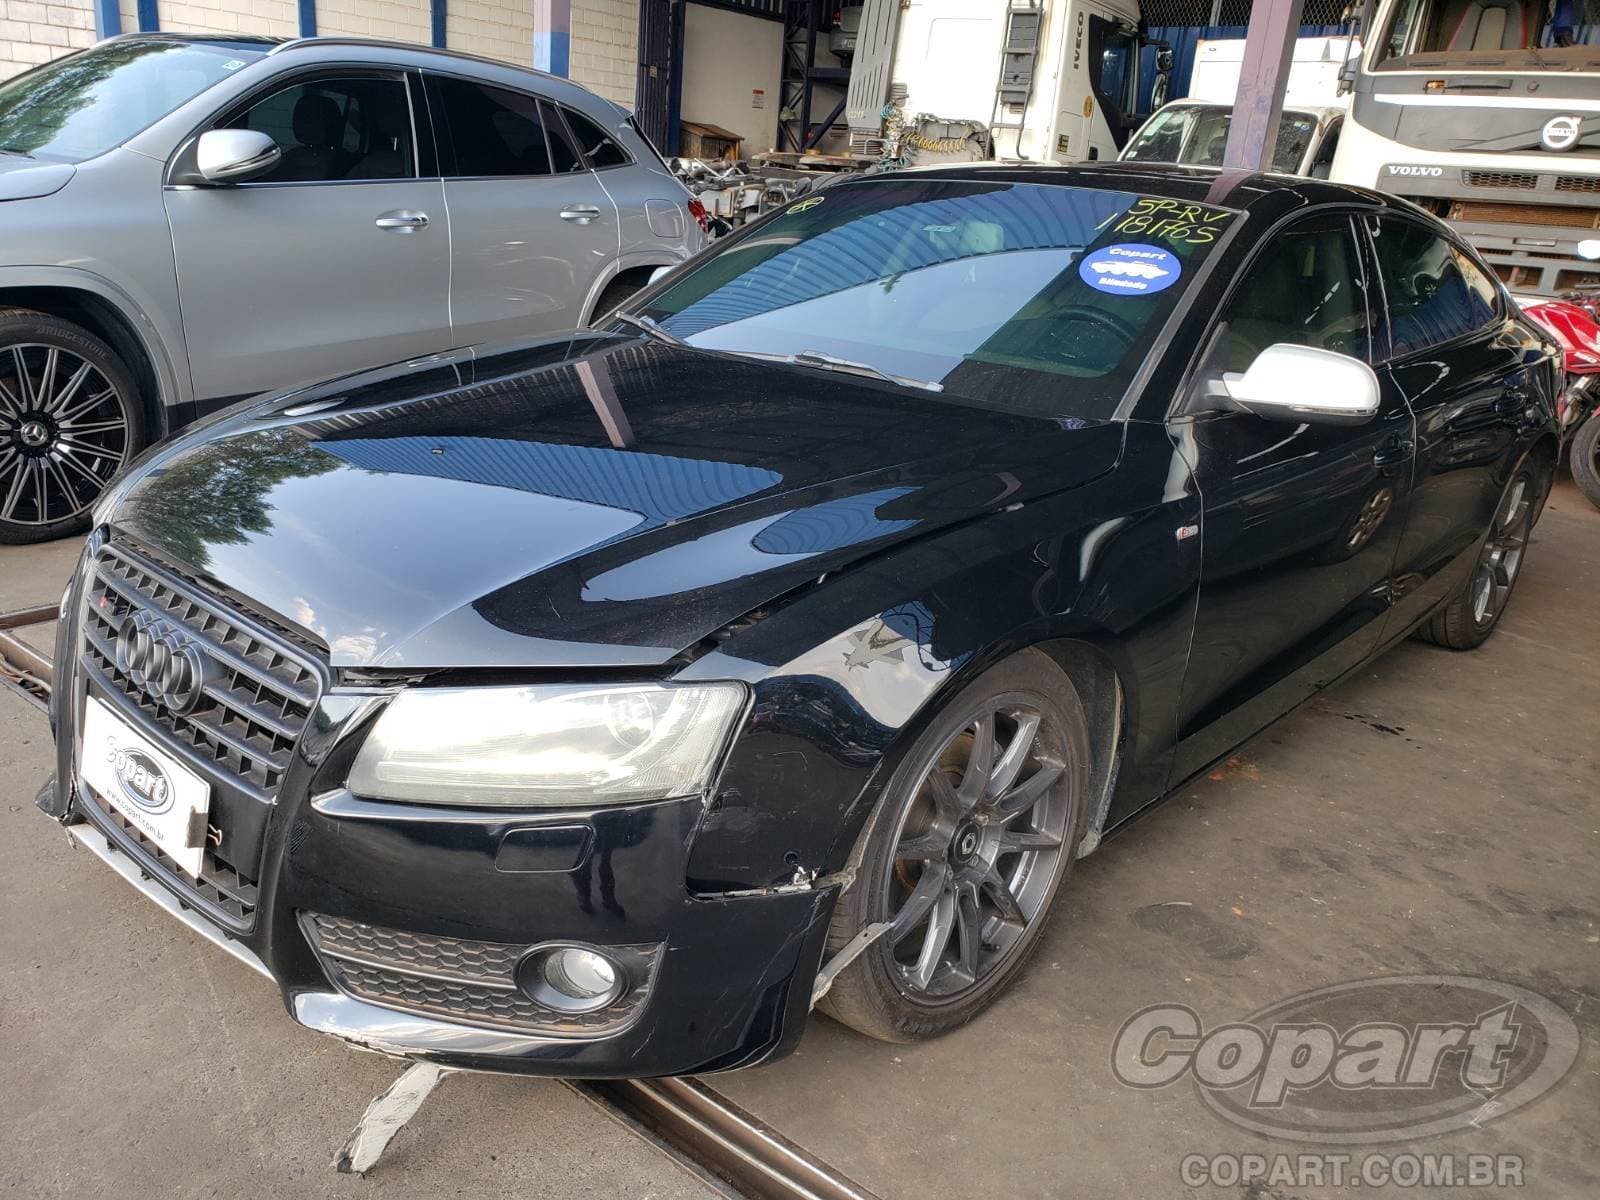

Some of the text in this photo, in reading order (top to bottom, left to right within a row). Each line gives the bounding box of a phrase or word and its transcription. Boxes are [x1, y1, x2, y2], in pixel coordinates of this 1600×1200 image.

[1073, 11, 1084, 70] IVECO
[1388, 165, 1443, 177] VOLVO
[1109, 249, 1168, 261] Copart
[105, 735, 168, 801] Copart
[106, 790, 165, 842] www.copart.com.br
